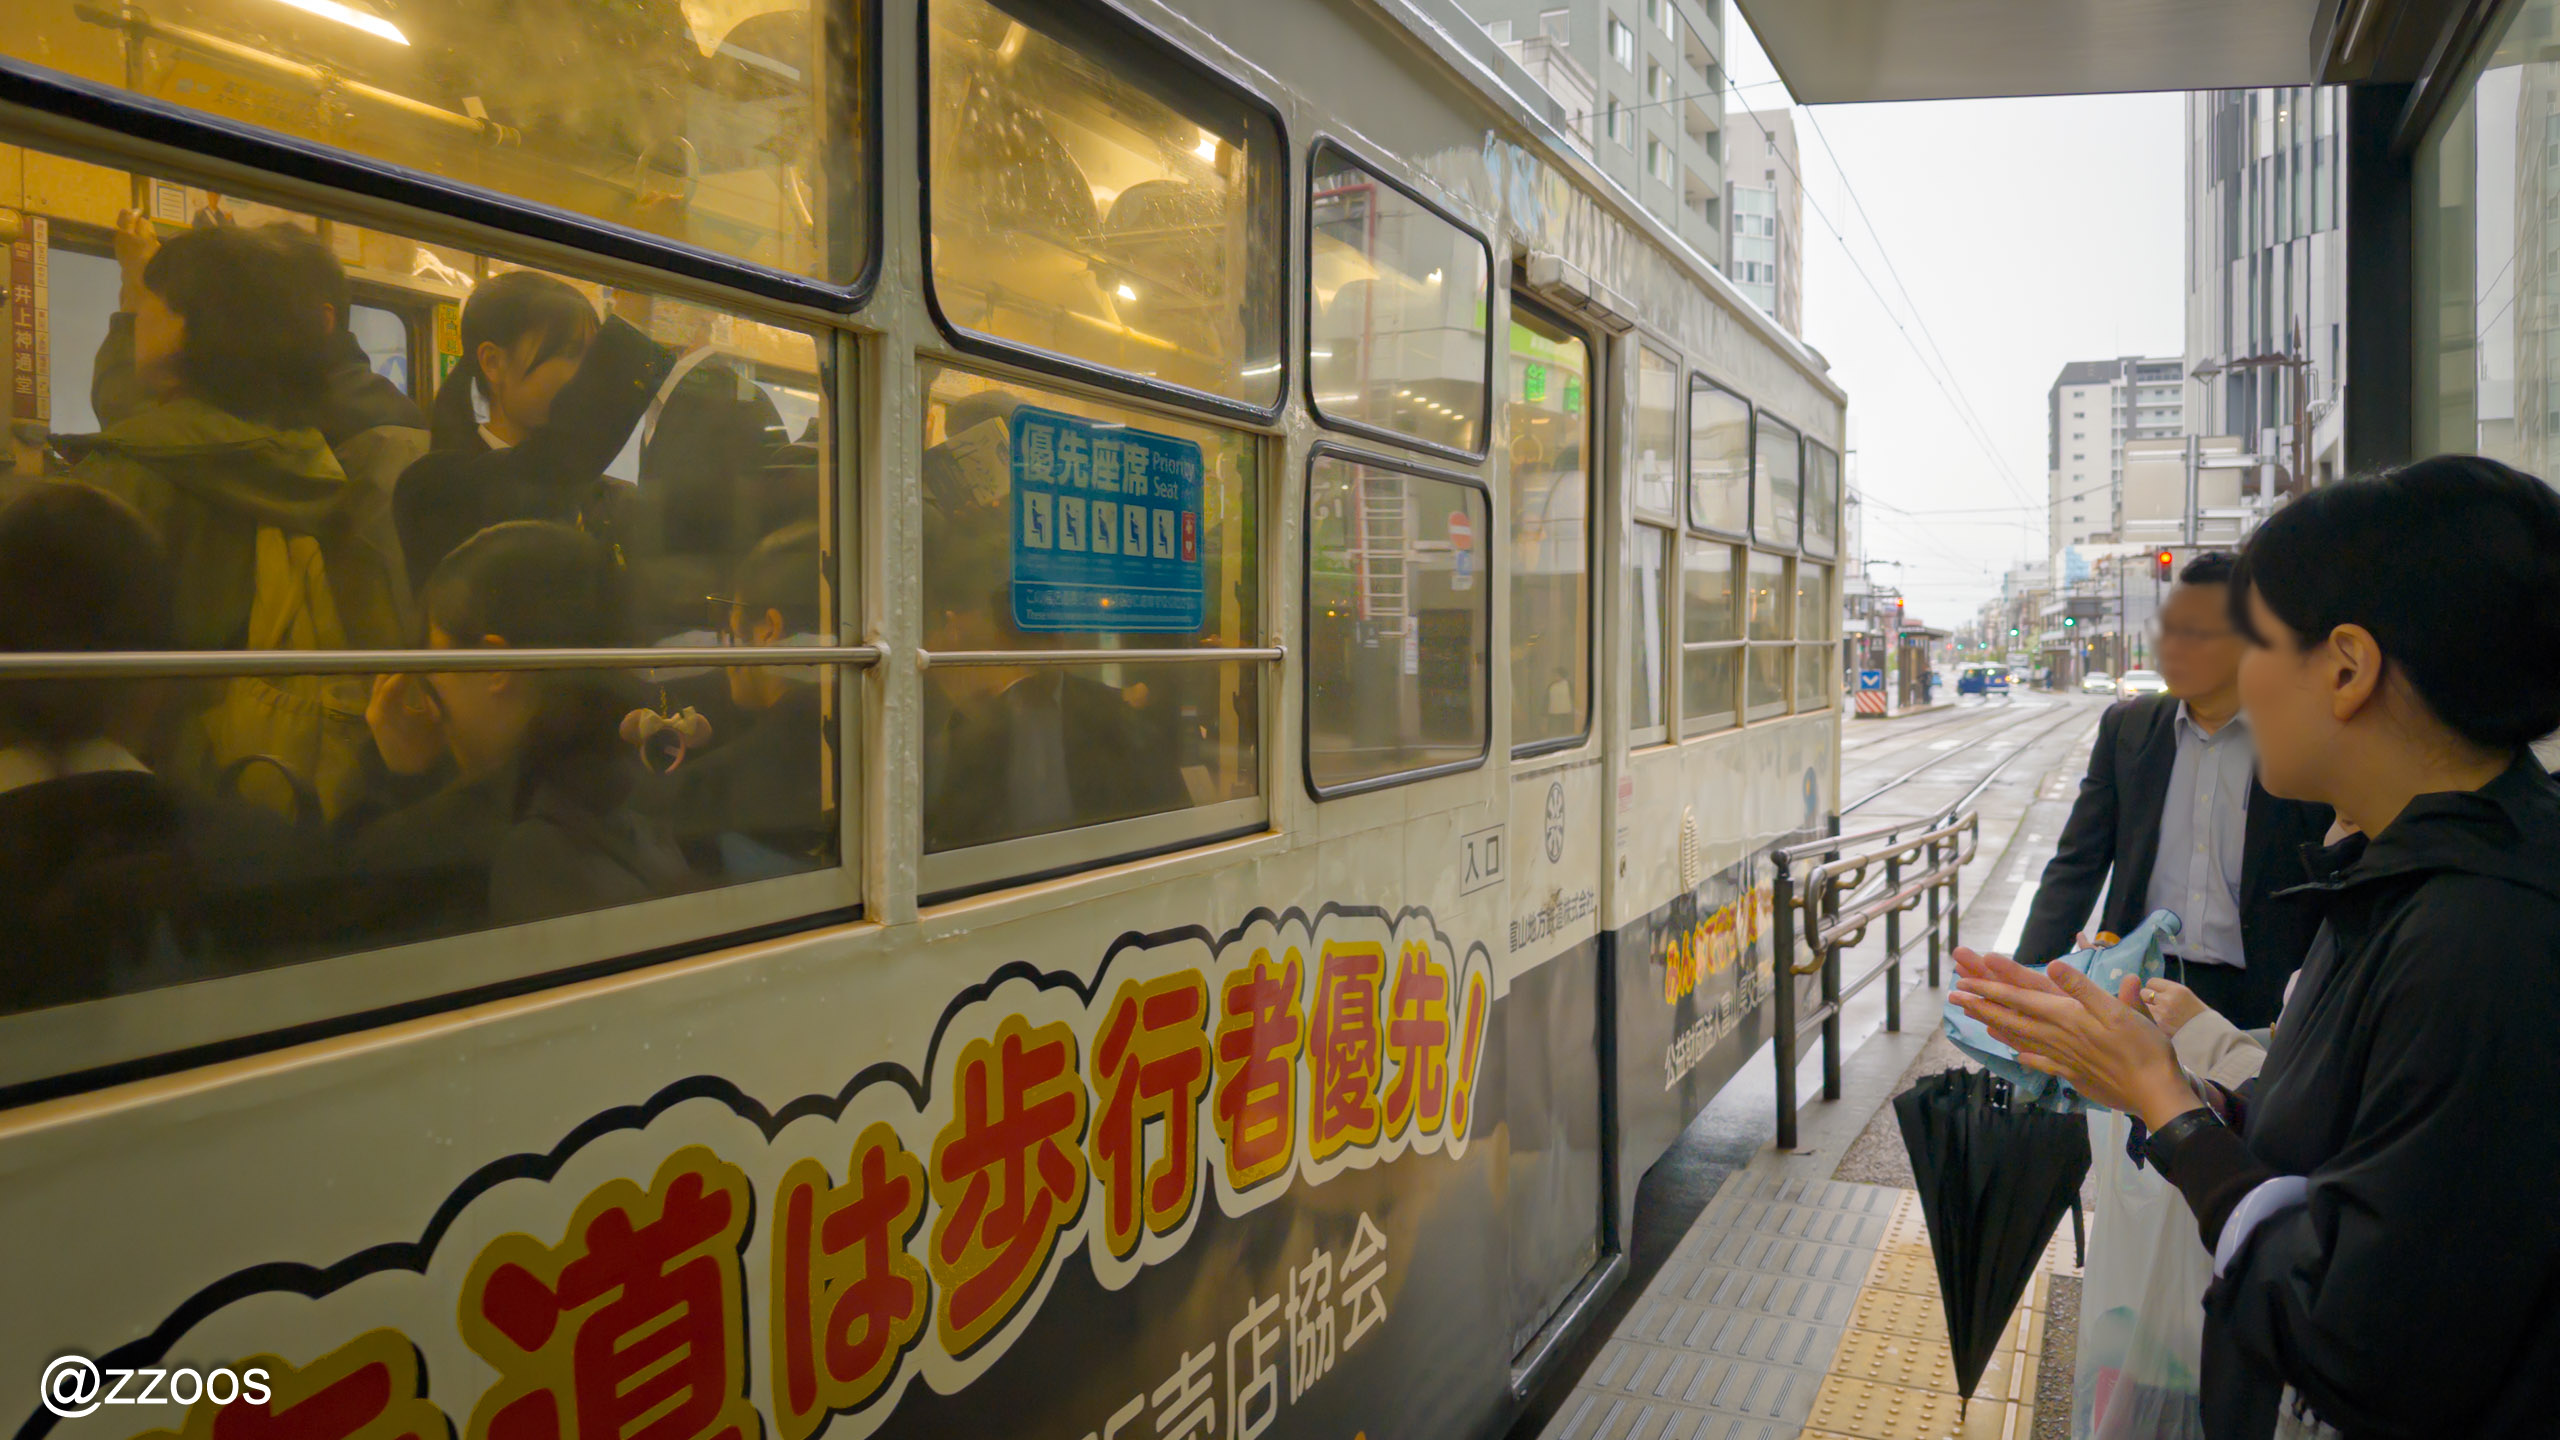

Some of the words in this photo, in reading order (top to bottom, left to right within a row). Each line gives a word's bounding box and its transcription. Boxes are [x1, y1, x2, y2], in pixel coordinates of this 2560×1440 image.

[1020, 420, 1151, 497] 優先座席
[1152, 451, 1196, 484] Priority
[1153, 475, 1180, 501] Seat
[1464, 835, 1501, 884] 入口
